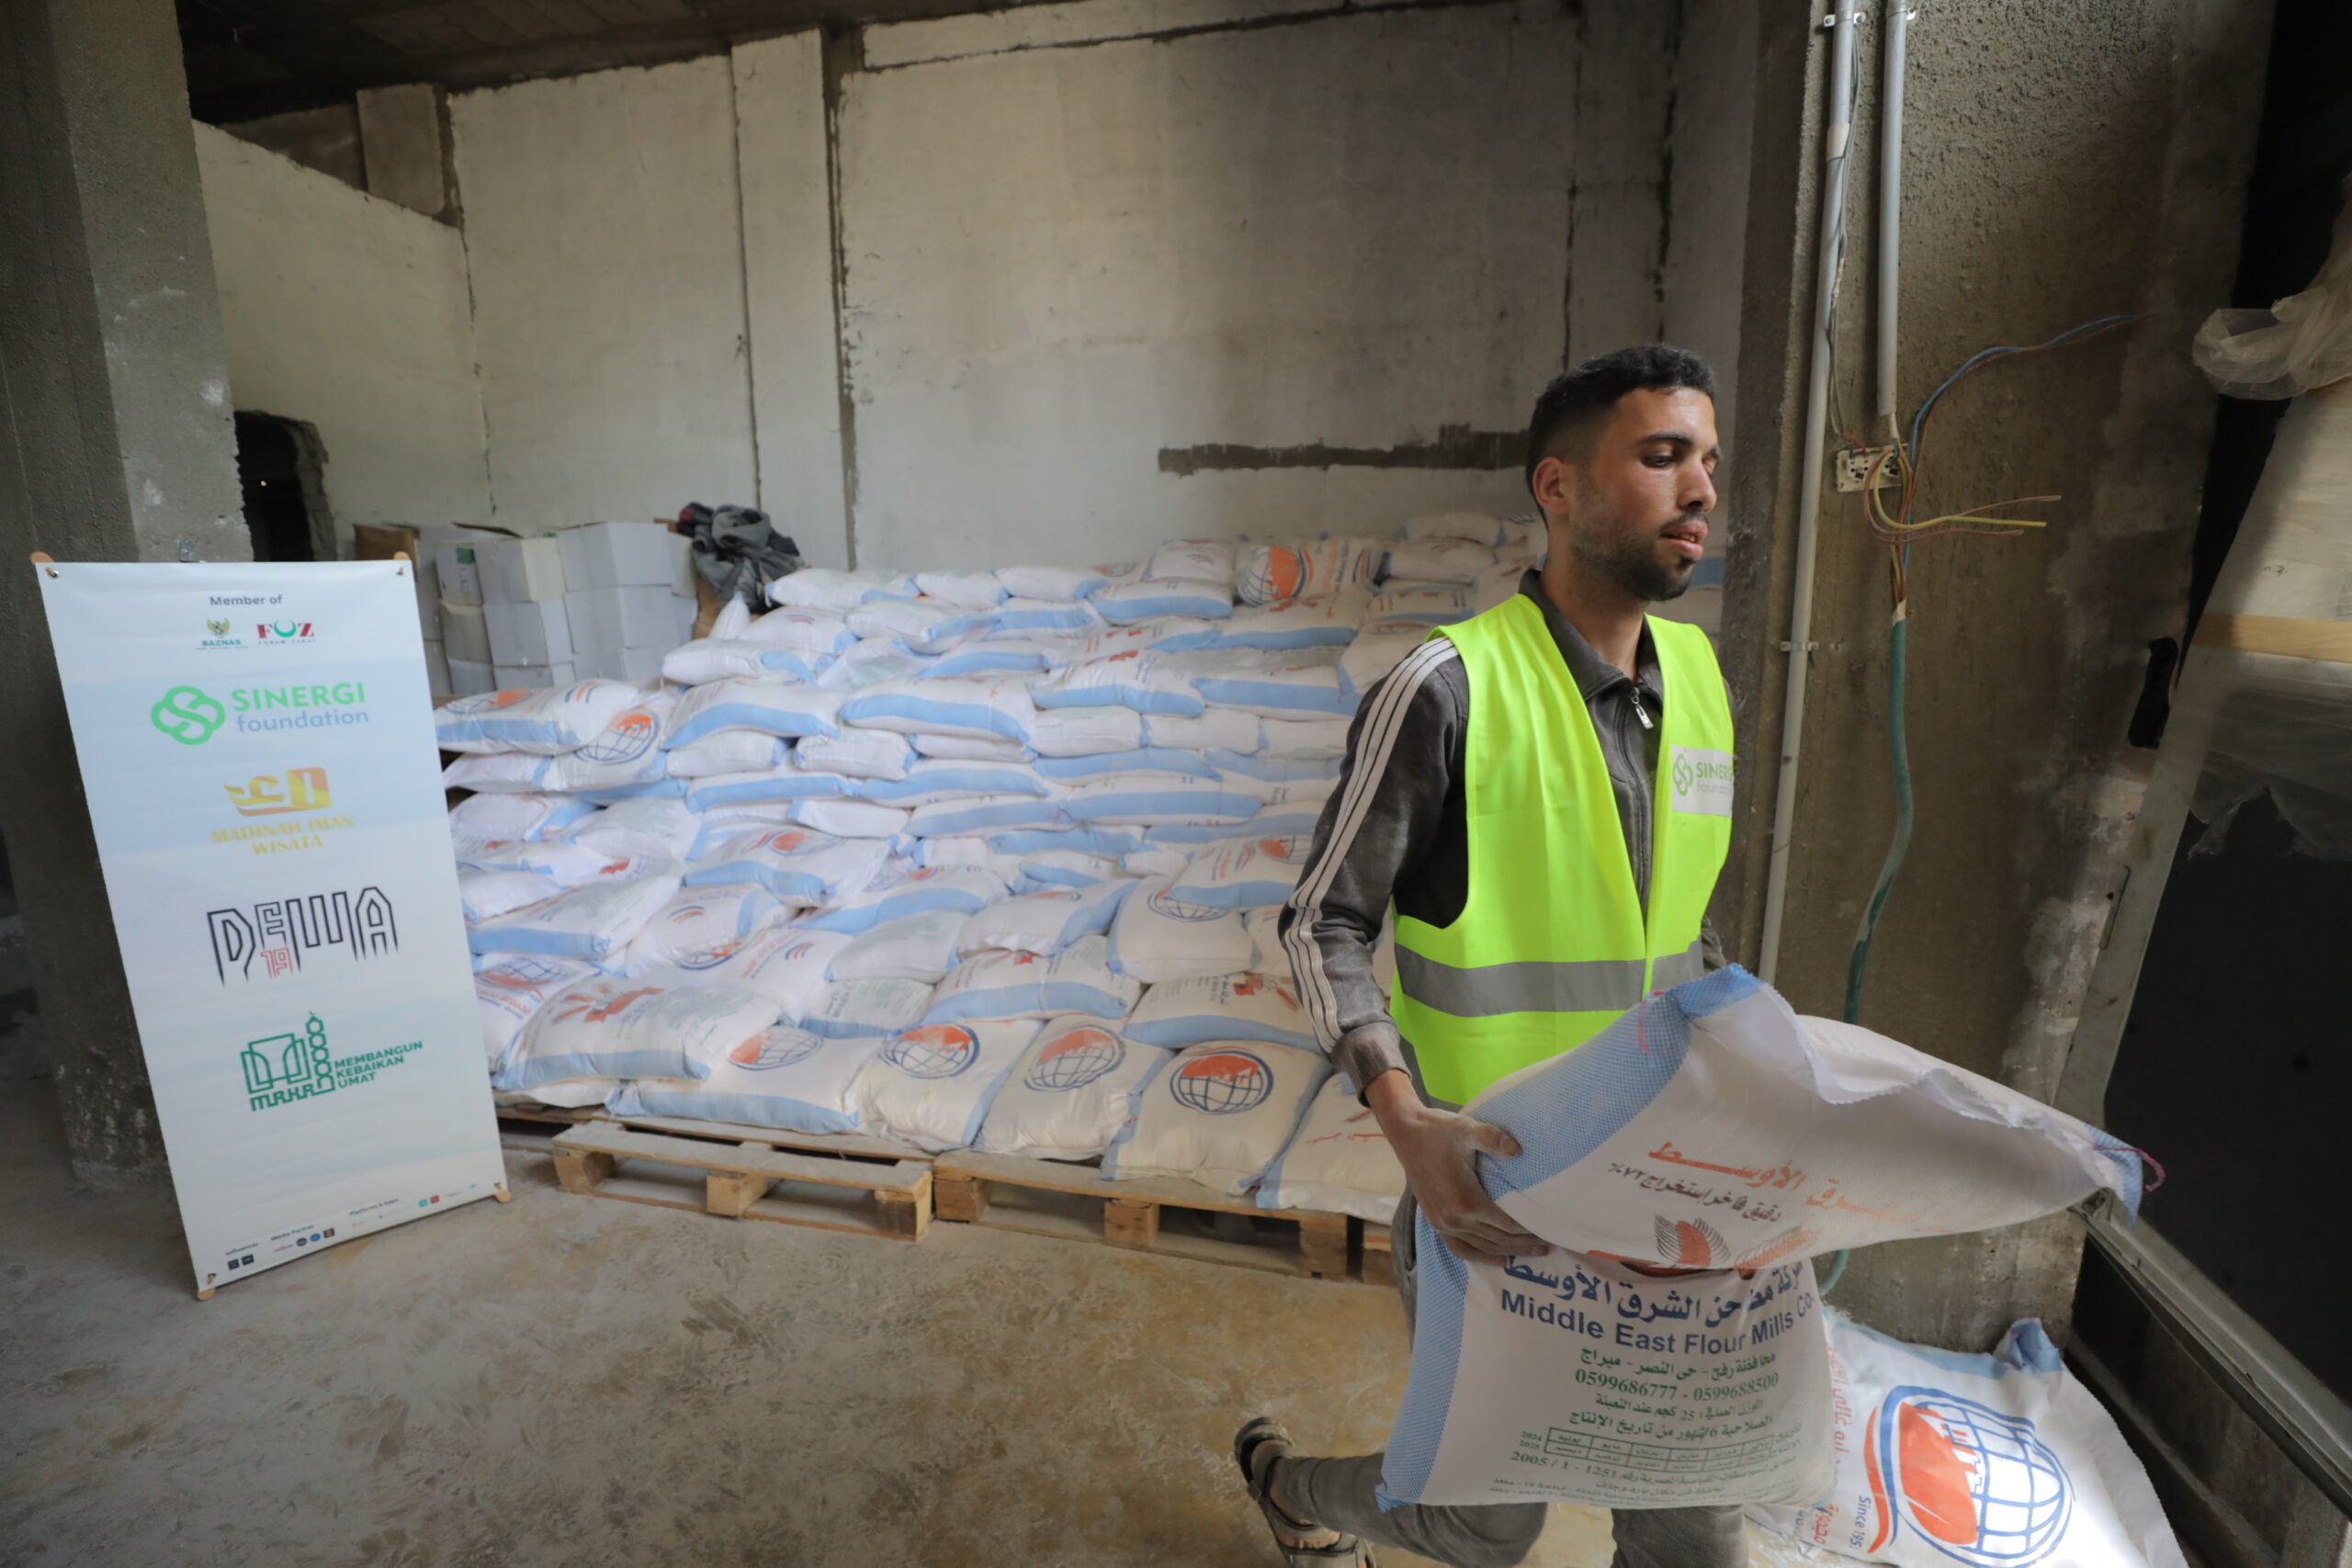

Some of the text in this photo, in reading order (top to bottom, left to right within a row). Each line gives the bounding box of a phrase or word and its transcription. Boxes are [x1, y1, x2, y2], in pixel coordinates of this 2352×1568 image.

[209, 593, 283, 606] Member of
[201, 638, 242, 647] BAZNAS
[231, 682, 366, 713] SINERGI
[236, 709, 369, 733] foundation
[211, 815, 354, 844] MADINAH IMAN
[251, 835, 323, 855] WISATA
[334, 1041, 424, 1069] MEMBANGUN
[335, 1055, 405, 1079] KEBAIKAN
[337, 1072, 377, 1089] UMAT
[1617, 1281, 1701, 1323] الشرق
[1500, 1288, 1605, 1339] Middle
[1615, 1323, 1676, 1354] East
[1684, 1332, 1747, 1355] Flour
[1751, 1309, 1794, 1346] Mills
[1580, 1348, 1621, 1369] ميراج
[1575, 1368, 1678, 1400] 0599686777
[1510, 1450, 1548, 1466] 2005
[1849, 1495, 1871, 1550] Since 195
